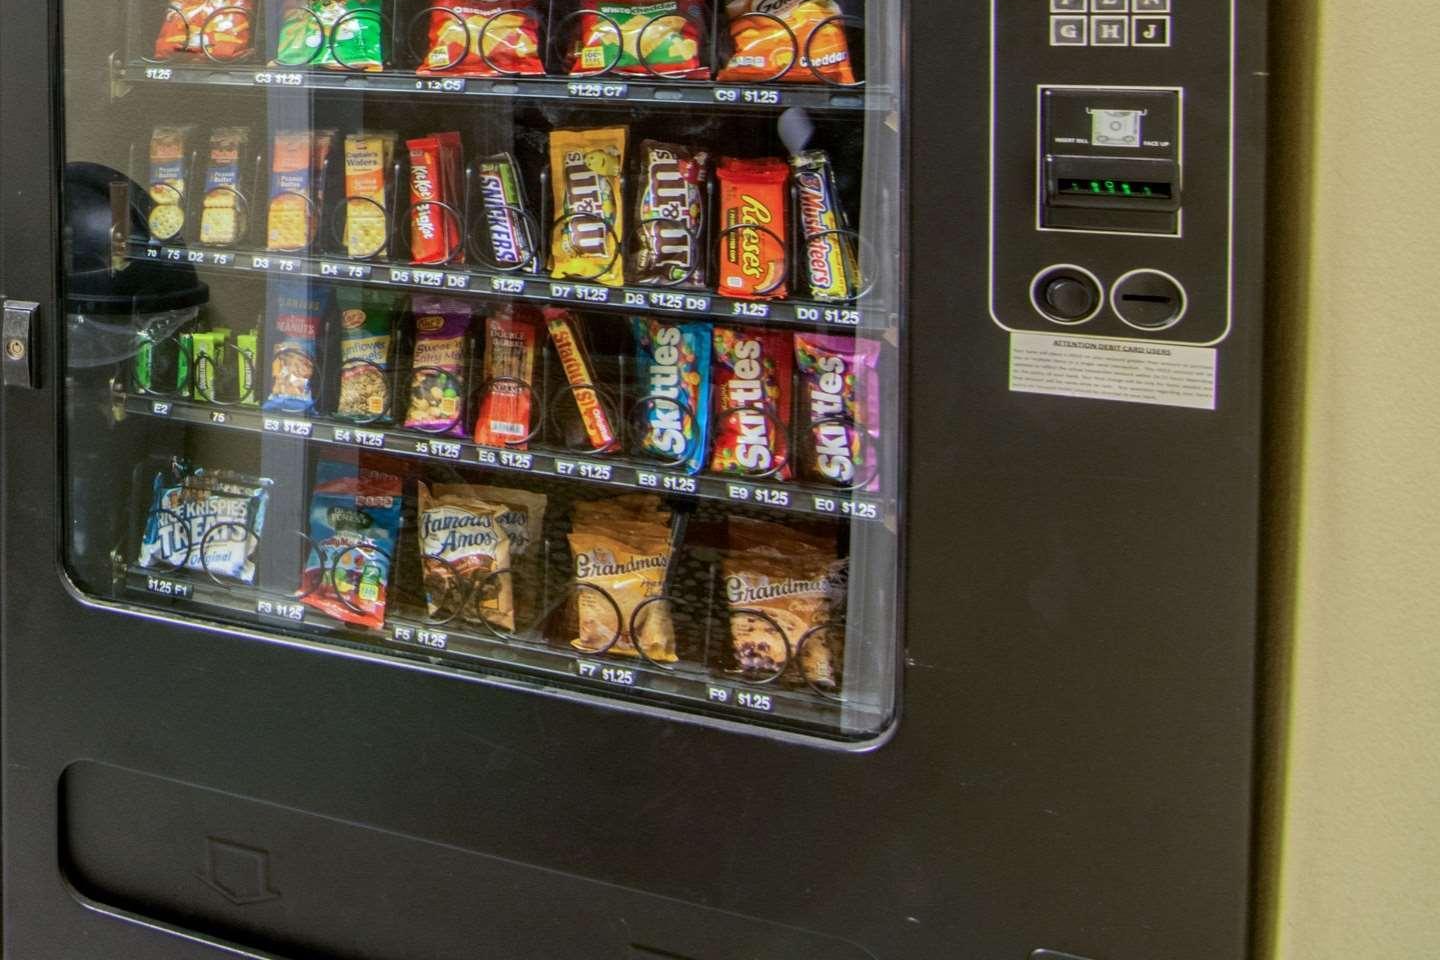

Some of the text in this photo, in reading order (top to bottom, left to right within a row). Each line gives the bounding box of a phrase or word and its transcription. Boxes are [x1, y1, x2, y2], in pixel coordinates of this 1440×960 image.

[255, 72, 302, 86] C3 $1.25
[443, 80, 461, 91] C5
[569, 84, 623, 96] $1.25 C7
[715, 90, 778, 104] C9 $1.25
[481, 174, 520, 263] SNICKERS
[741, 193, 773, 278] Reese's
[252, 257, 294, 271] D3 75
[320, 262, 363, 277] D4 75
[391, 271, 441, 285] D5 $1.25
[447, 275, 522, 292] D6 $1.25
[551, 285, 606, 301] D7 $1.25
[625, 293, 682, 308] D8 $1.25
[686, 297, 768, 317] D9 $1.25
[650, 327, 686, 455] Skittles
[153, 403, 168, 414] E2
[728, 339, 772, 471] Skittles
[263, 419, 311, 436] E3 $1.25
[811, 356, 855, 482] Skittles
[334, 429, 384, 447] E4 $1.25
[430, 443, 460, 458] $1.25
[478, 450, 530, 468] E6 $1.25
[557, 461, 611, 479] E7 $1.25
[638, 473, 696, 492] E8 $1.25
[729, 486, 788, 506] E9 $1.25
[186, 497, 248, 519] KRISPIES
[422, 511, 493, 539] Famous
[159, 515, 249, 561] TREATS
[435, 529, 494, 558] Amos
[575, 552, 668, 578] Grandma's
[147, 578, 188, 596] $1.25 F1
[257, 601, 303, 619] F3 $1.25
[395, 627, 447, 648] F5 $1.25
[578, 664, 633, 684] F7 $1.25
[709, 690, 771, 711] F9 $1.25
